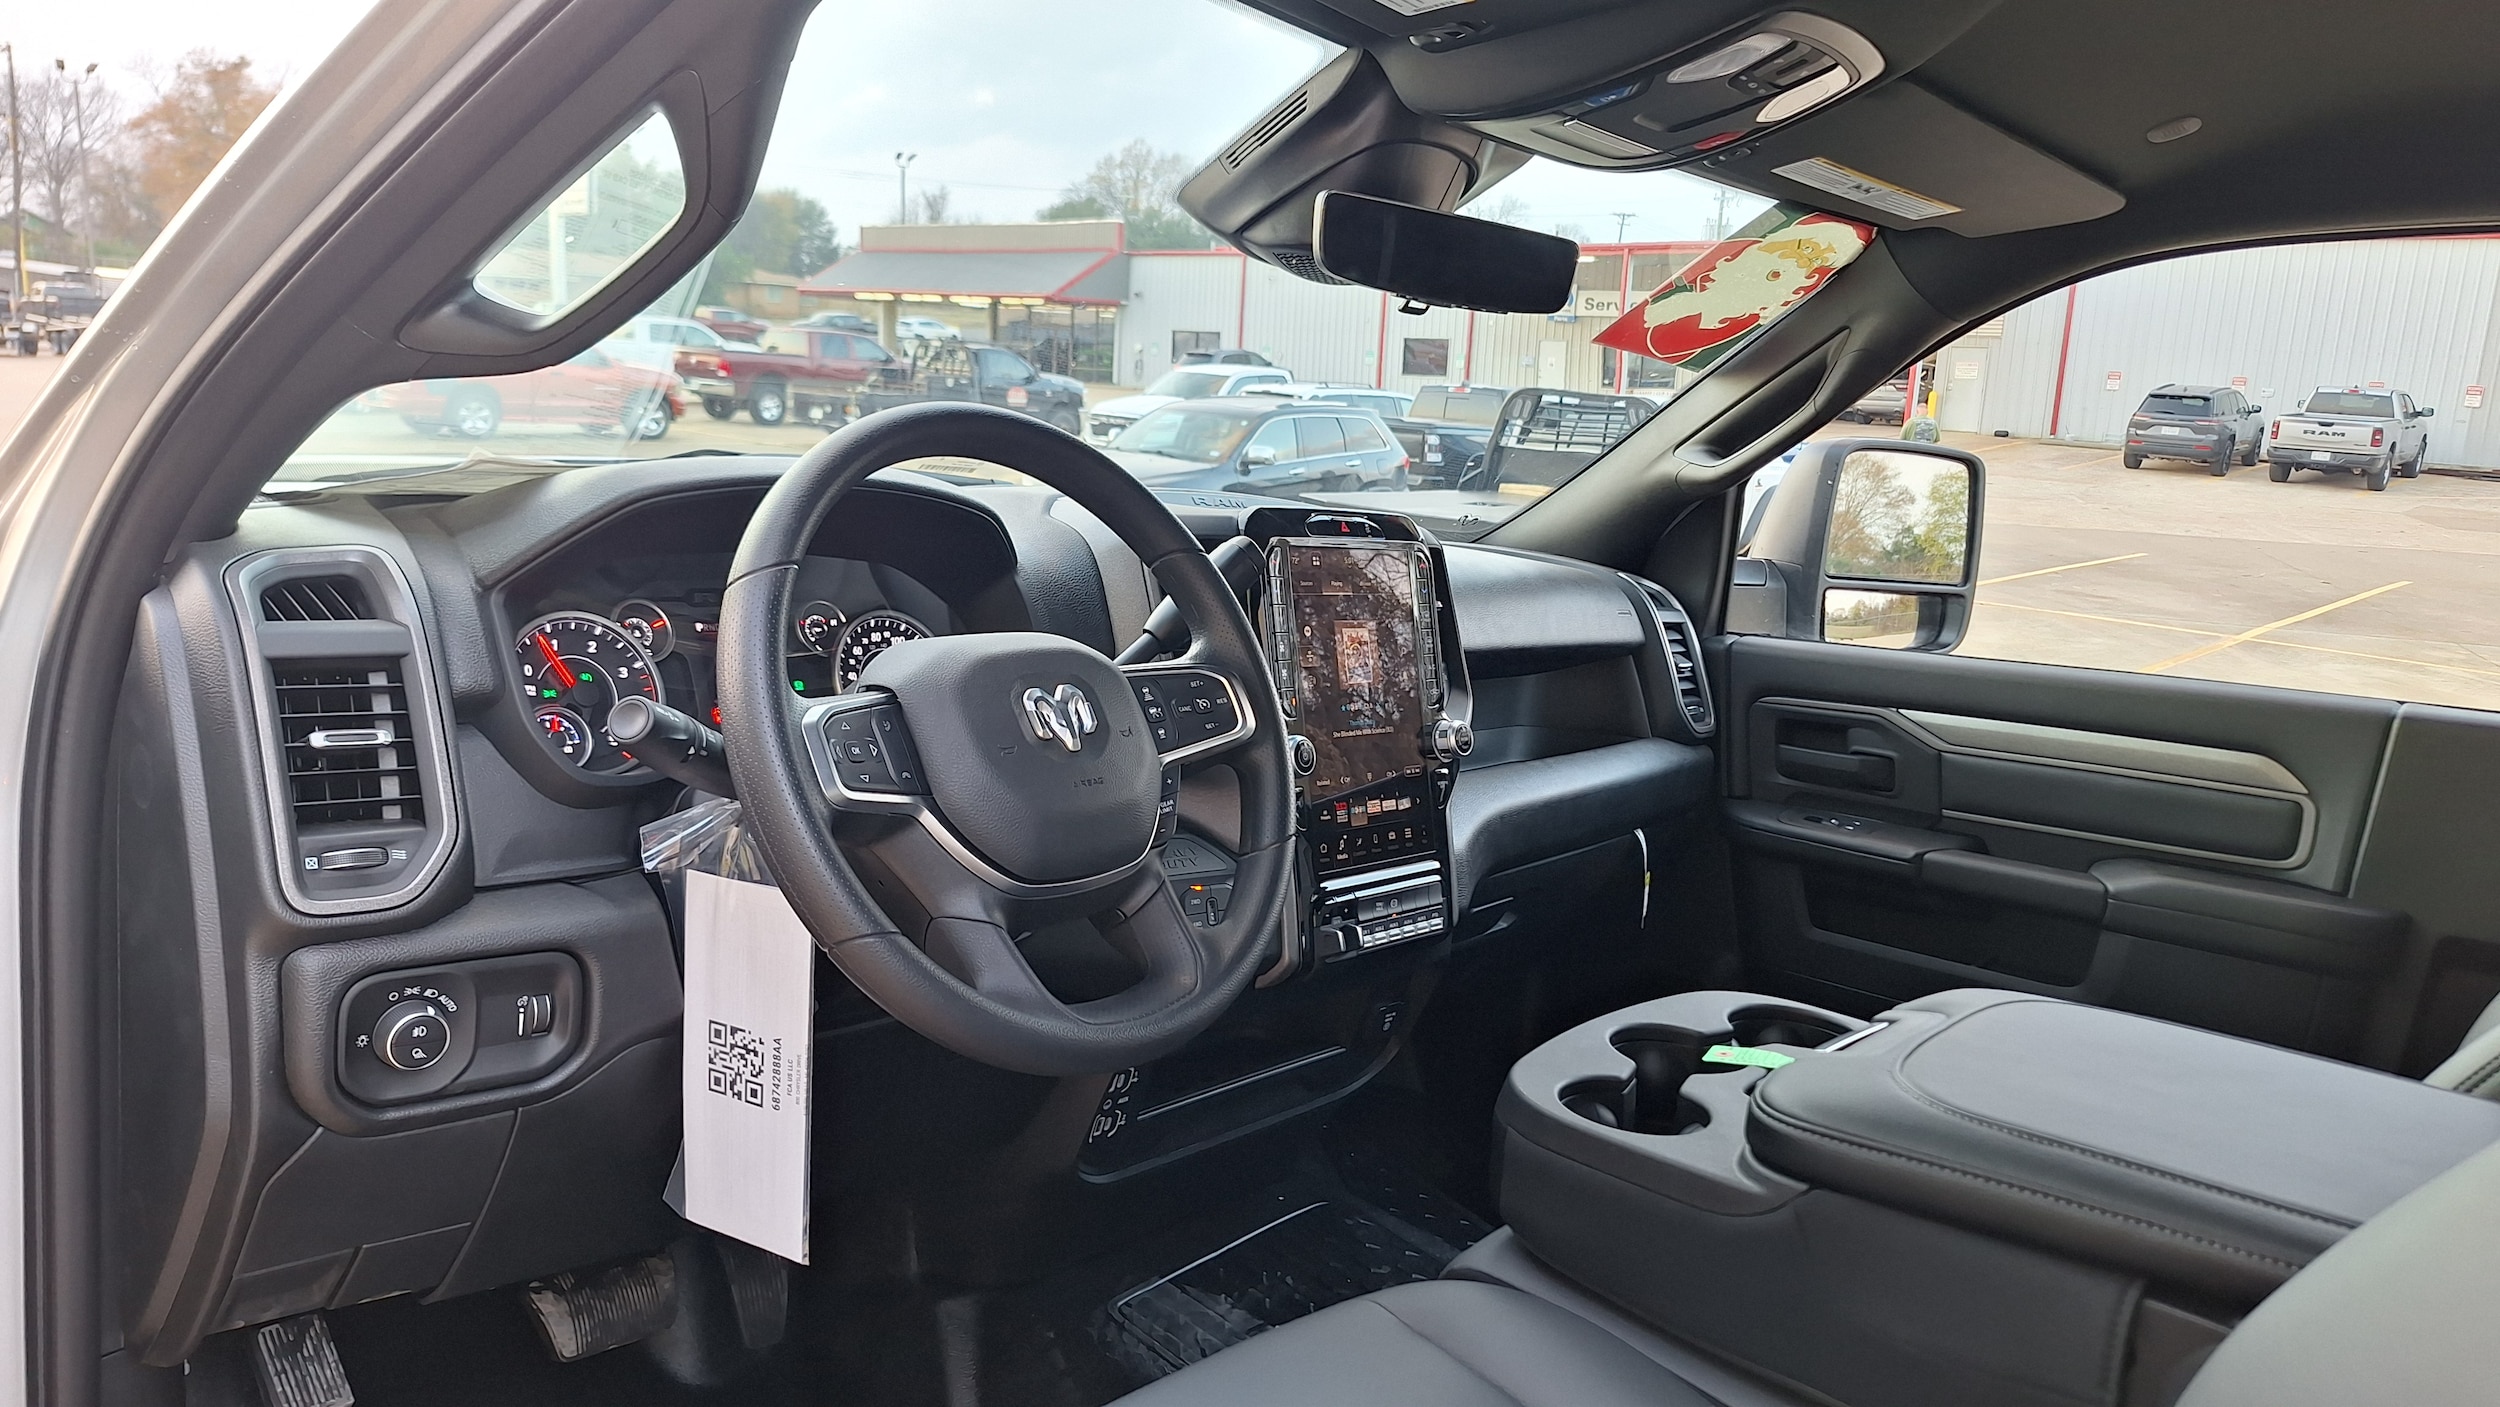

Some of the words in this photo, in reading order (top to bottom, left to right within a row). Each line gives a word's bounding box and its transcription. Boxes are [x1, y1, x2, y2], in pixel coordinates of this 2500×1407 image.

[2303, 429, 2346, 437] RAM
[1192, 495, 1248, 508] RAM
[870, 632, 882, 642] 80
[587, 641, 598, 653] 2
[852, 646, 863, 655] 60
[524, 664, 533, 676] 0
[617, 667, 629, 678] 3
[847, 671, 858, 681] 40
[1190, 680, 1204, 688] SET+
[851, 746, 861, 754] OK
[1073, 777, 1104, 788] AIRBAG
[438, 994, 458, 1012] AUTO
[771, 1037, 782, 1111] 68742888AA
[787, 1072, 793, 1082] US
